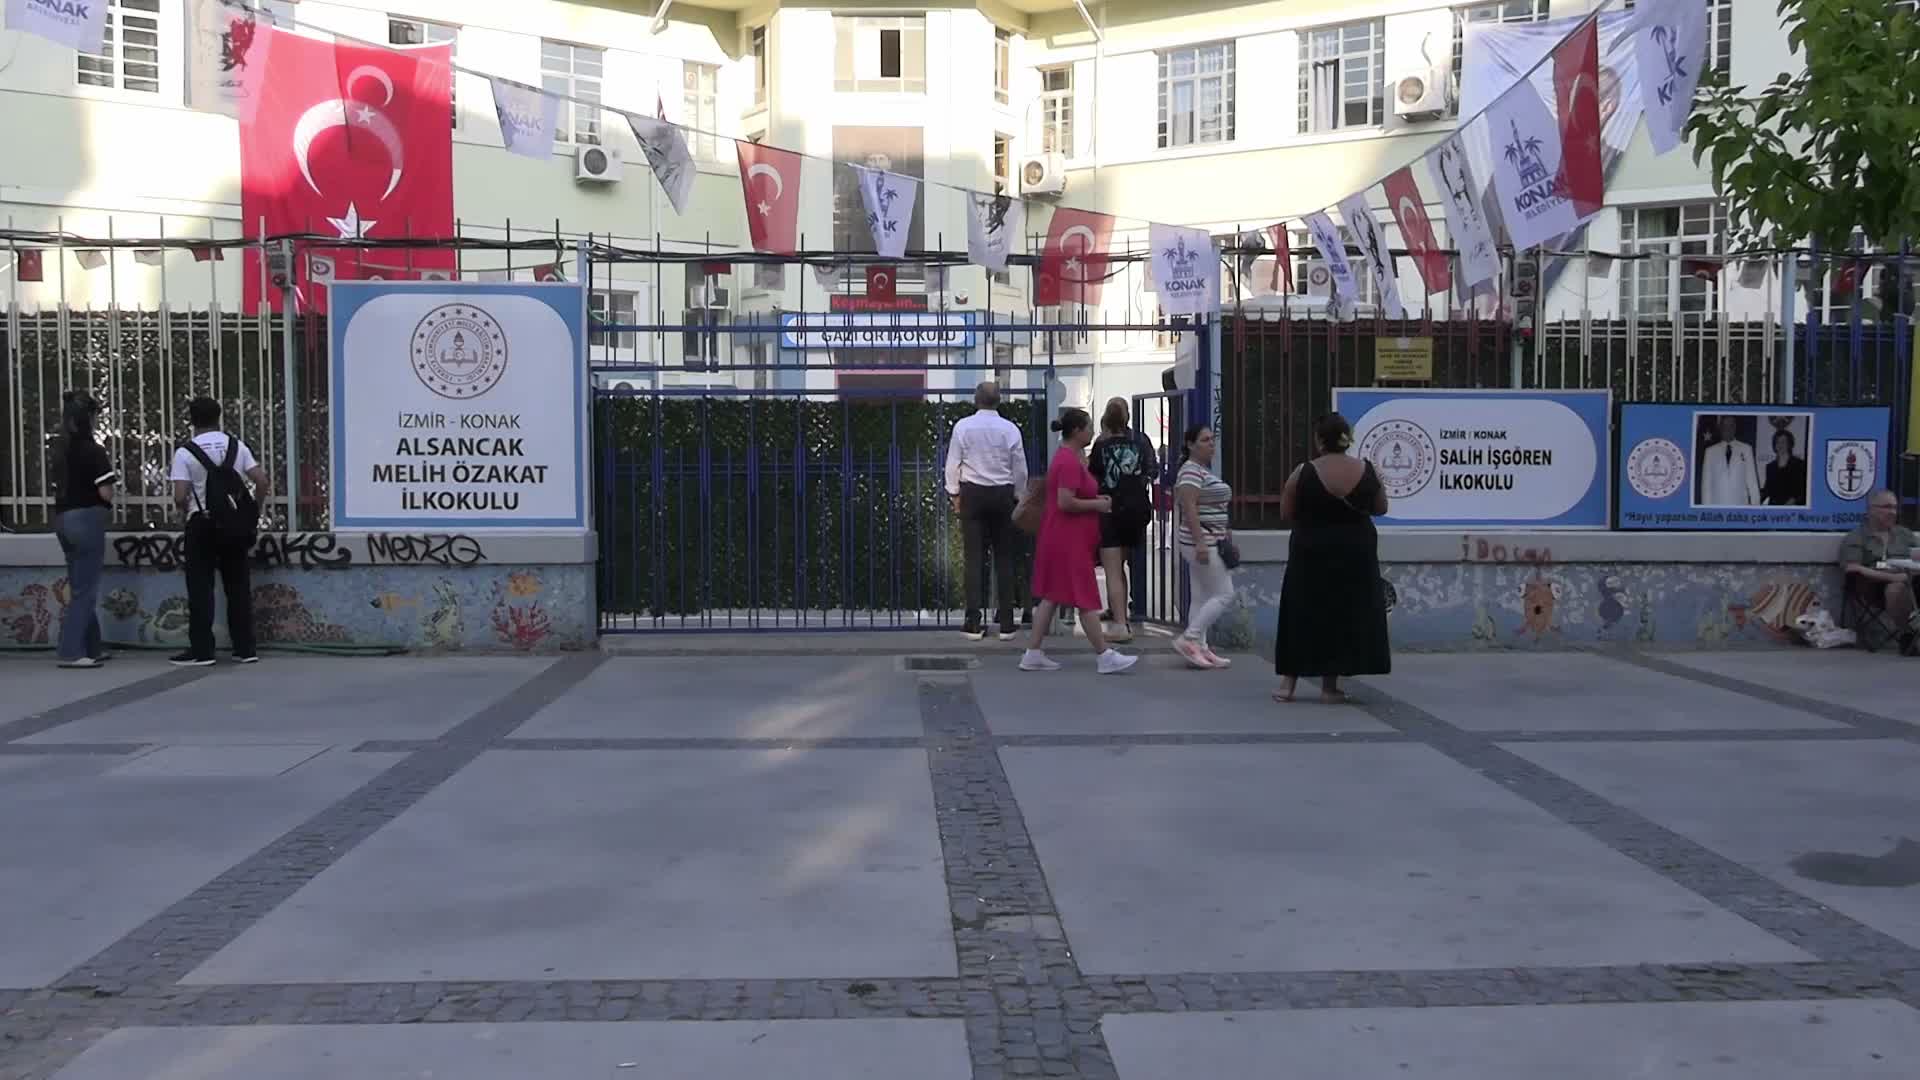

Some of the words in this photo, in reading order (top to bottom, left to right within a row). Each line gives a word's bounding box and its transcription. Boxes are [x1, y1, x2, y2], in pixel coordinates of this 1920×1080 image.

[1164, 278, 1206, 292] KONAK
[398, 411, 446, 429] İZMİR
[460, 414, 521, 429] KONAK
[1439, 429, 1467, 440] İZMİR
[1473, 431, 1508, 440] KONAK
[396, 437, 525, 456] ALSANCAK
[1439, 446, 1483, 466] SALİH
[1488, 446, 1552, 469] İŞGÖREN
[372, 460, 446, 483] MELİH
[452, 460, 549, 483] ÖZAKAT
[1439, 472, 1514, 490] İLKOKULU
[401, 487, 520, 510] İLKOKULU
